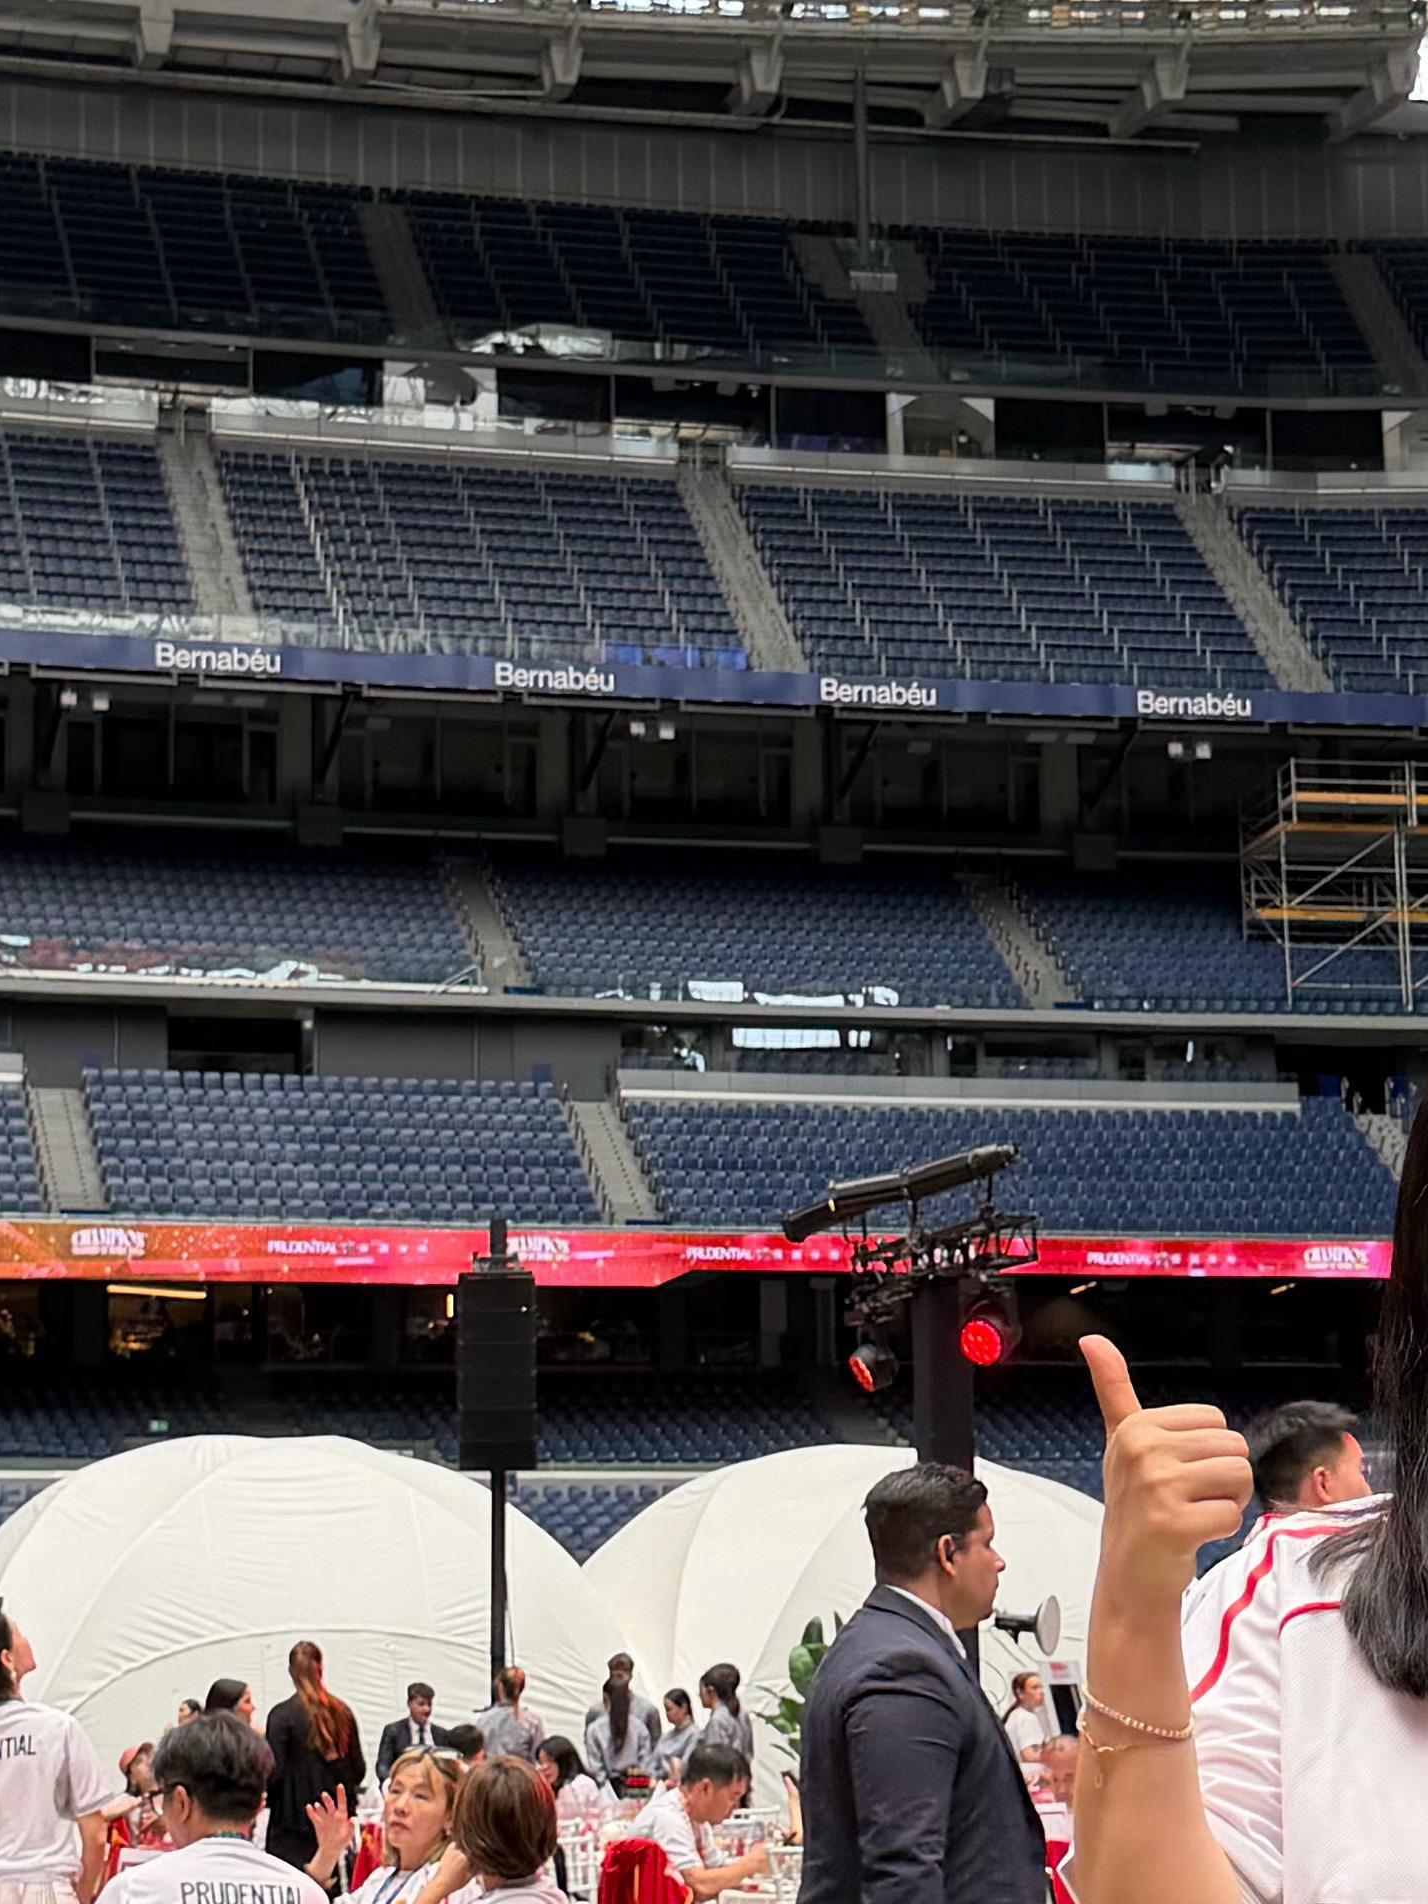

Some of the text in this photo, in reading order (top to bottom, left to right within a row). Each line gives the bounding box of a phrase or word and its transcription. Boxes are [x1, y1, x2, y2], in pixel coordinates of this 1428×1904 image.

[155, 642, 281, 675] Bernabéu
[494, 661, 615, 693] Bernabéu
[820, 677, 936, 707] Bernabéu
[1137, 690, 1252, 719] Bernabéu
